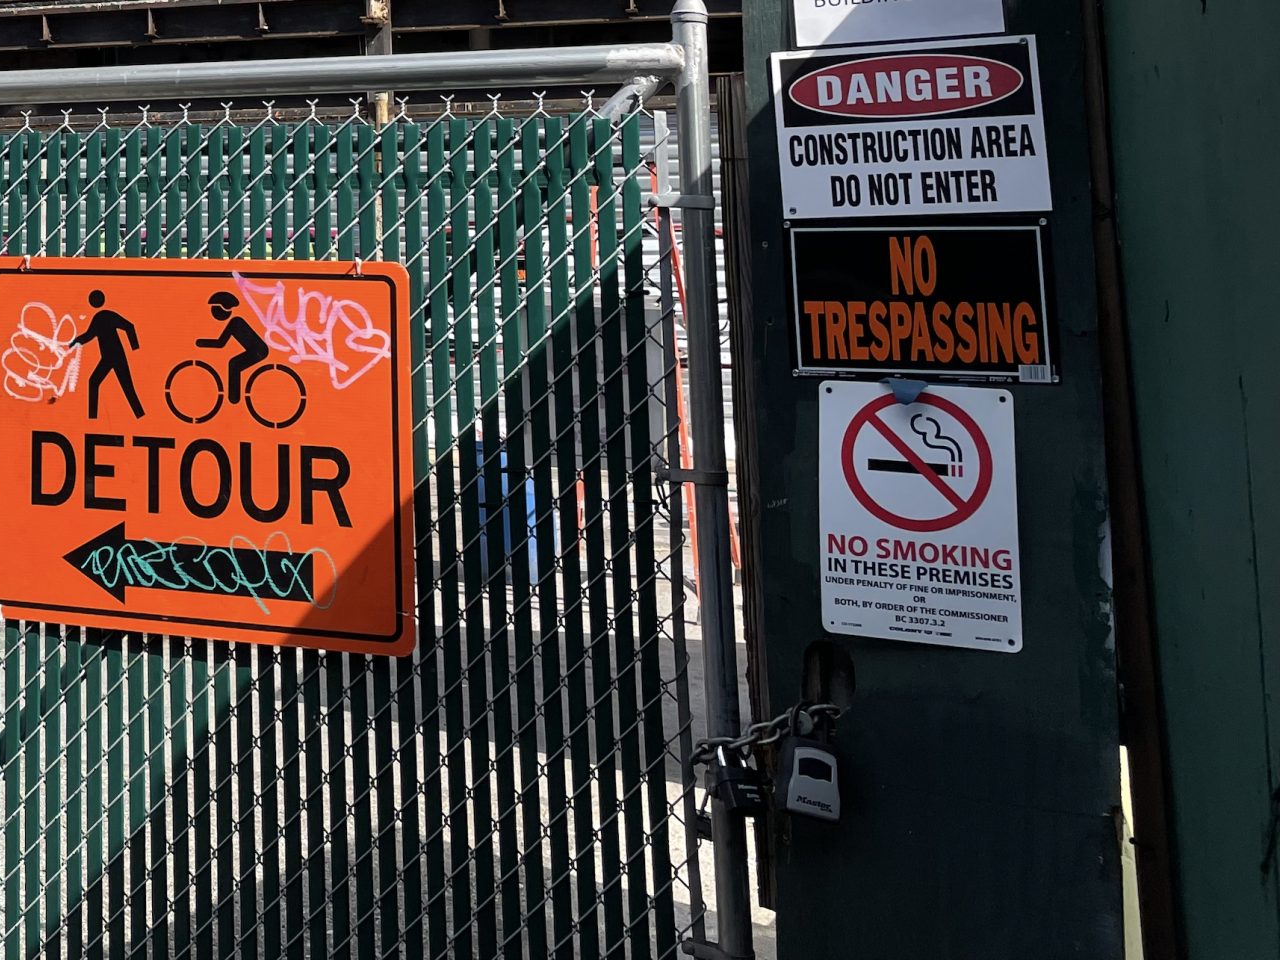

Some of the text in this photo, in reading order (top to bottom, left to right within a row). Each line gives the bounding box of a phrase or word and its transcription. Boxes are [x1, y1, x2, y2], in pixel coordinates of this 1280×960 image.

[816, 65, 993, 107] DANGER
[789, 123, 1036, 167] CONSTRUCTION AREA
[830, 169, 998, 207] DO NOT ENTER
[889, 235, 937, 296] NO
[803, 300, 1039, 364] TRESPASSING
[30, 430, 353, 528] DETOUR
[827, 533, 1012, 570] NO SMOKING
[825, 576, 1017, 603] UNDER PENALTY OF FINE OR IMPRISONMENT,
[828, 557, 1014, 589] IN THESE PREMISES
[834, 597, 1009, 623] BOTH, BY ORDER OF THE COMMISSIONER
[913, 595, 926, 603] OR
[895, 614, 946, 627] BC 3307.3.2
[796, 795, 832, 810] Master
